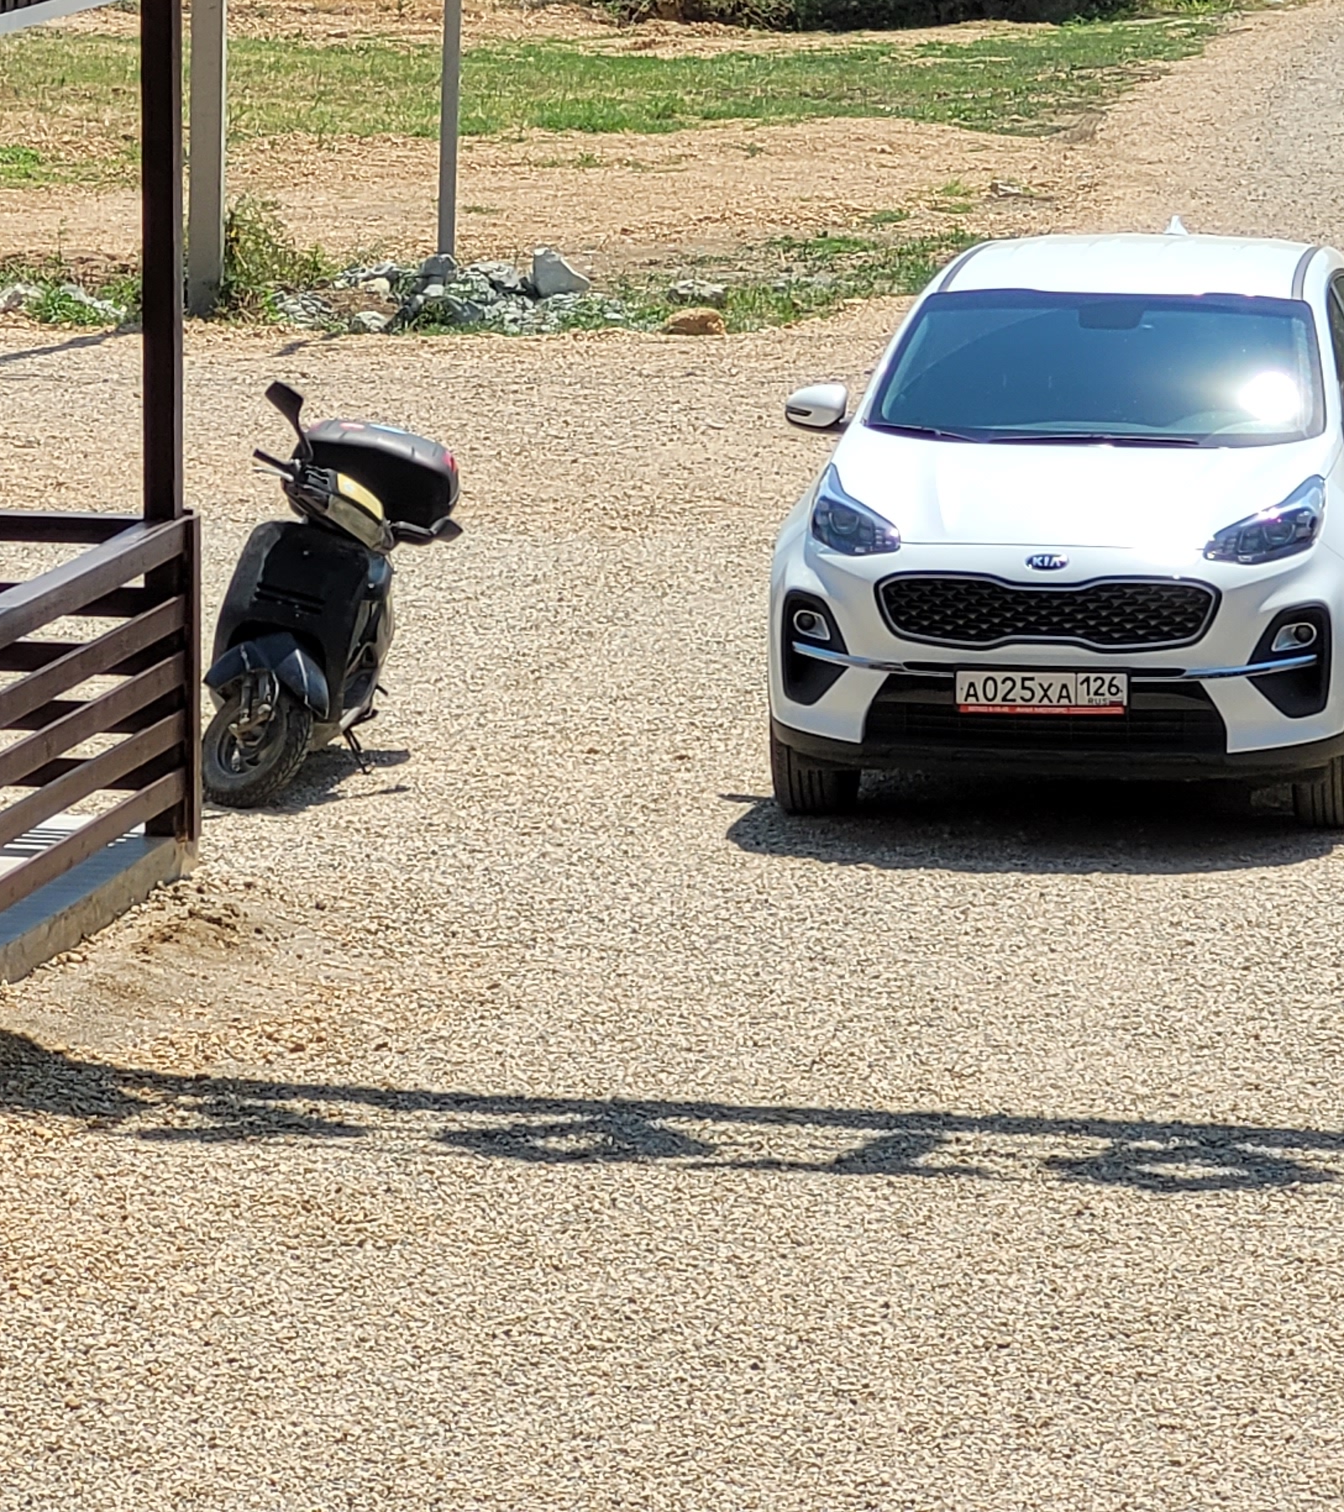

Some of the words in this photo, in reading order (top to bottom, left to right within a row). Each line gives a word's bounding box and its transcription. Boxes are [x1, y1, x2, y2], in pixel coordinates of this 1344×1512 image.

[1032, 556, 1061, 567] KIA
[964, 675, 1072, 704] А025ХА
[1079, 675, 1120, 697] 126
